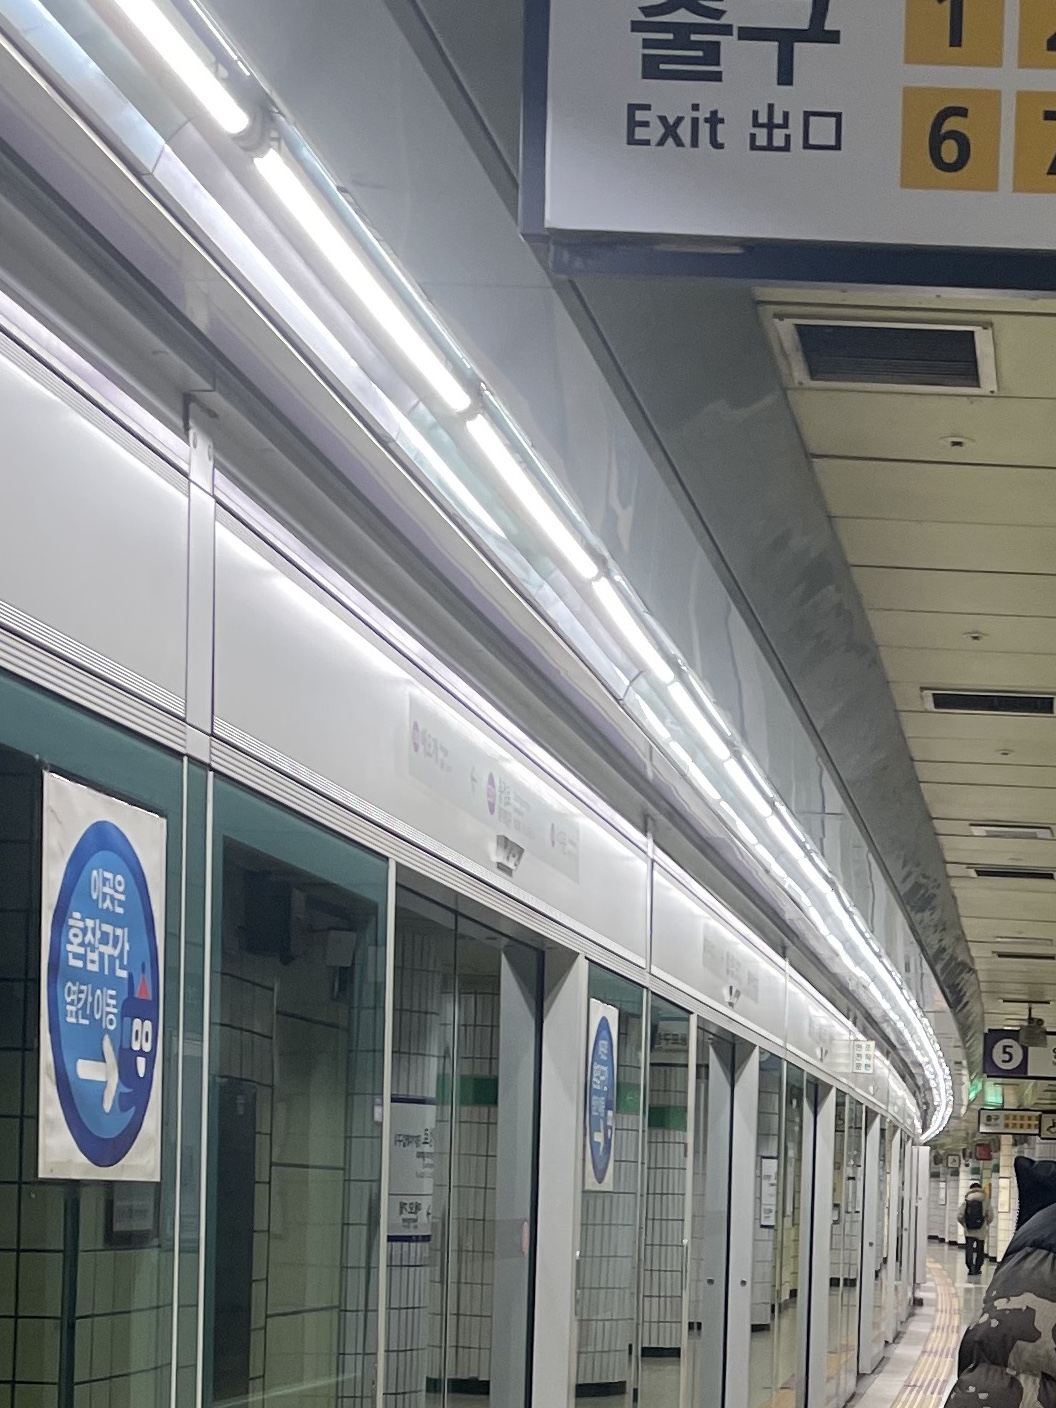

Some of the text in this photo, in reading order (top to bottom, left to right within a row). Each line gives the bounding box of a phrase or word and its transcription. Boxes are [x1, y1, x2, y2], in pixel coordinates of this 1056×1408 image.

[630, 0, 841, 86] 출구
[936, 0, 963, 48] 1
[626, 103, 842, 152] Exit 出口
[928, 106, 971, 172] 6
[90, 868, 126, 915] 이곳은
[66, 911, 129, 979] 혼잡구간
[1001, 1045, 1013, 1063] 5
